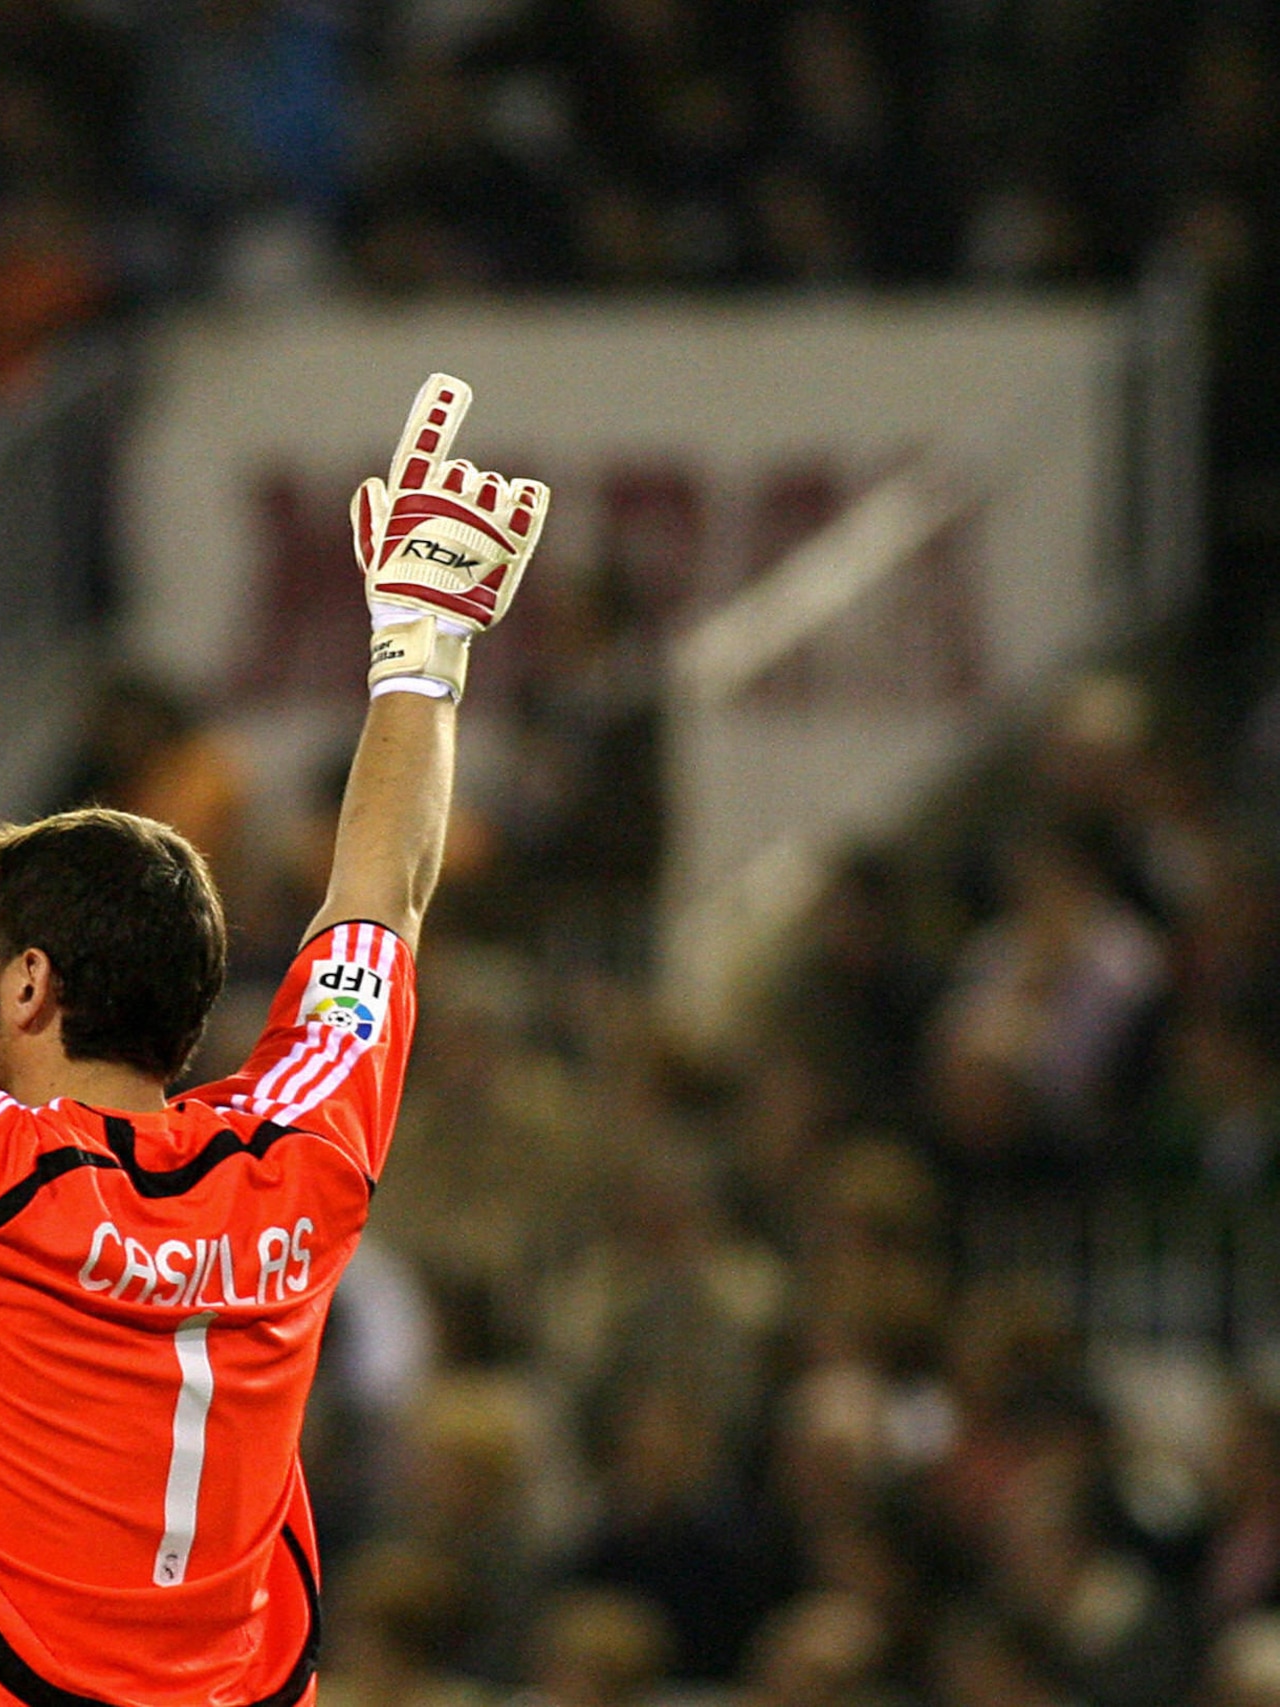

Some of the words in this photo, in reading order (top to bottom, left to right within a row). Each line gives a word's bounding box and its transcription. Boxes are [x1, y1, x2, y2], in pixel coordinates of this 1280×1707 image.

[401, 539, 480, 578] Rbk
[319, 965, 382, 999] LFP
[78, 1217, 314, 1307] CASILLAS
[152, 1310, 219, 1588] 1
